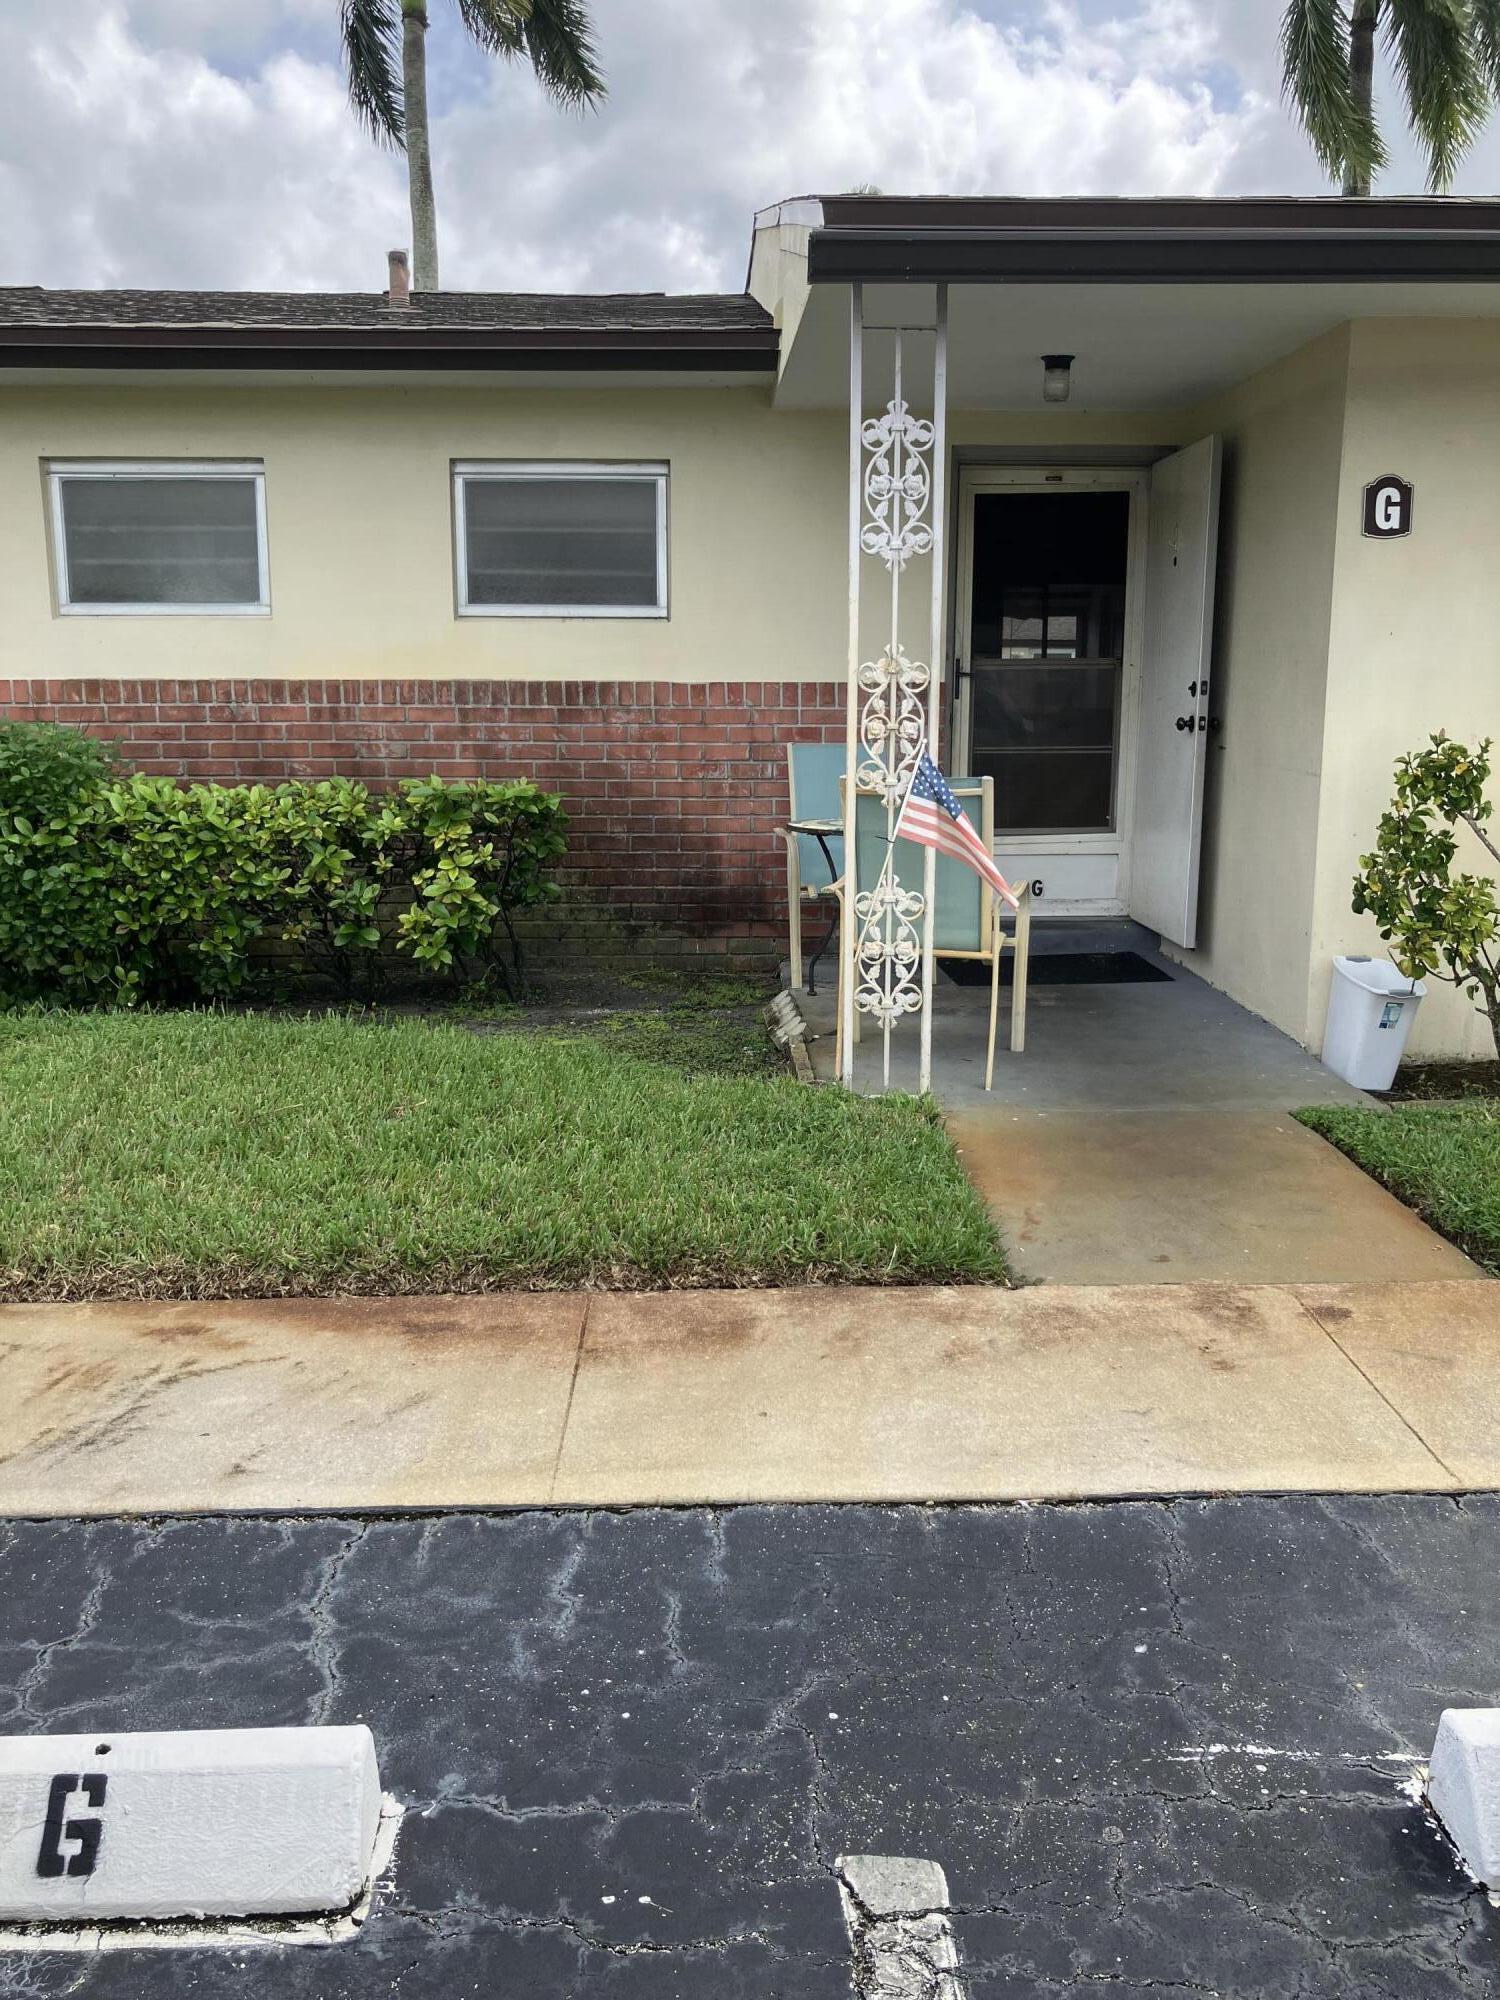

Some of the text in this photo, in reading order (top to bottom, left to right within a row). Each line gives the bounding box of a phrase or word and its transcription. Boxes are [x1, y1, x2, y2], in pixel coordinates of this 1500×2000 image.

[1375, 487, 1401, 530] G
[1031, 879, 1043, 897] G
[37, 1773, 108, 1877] G
